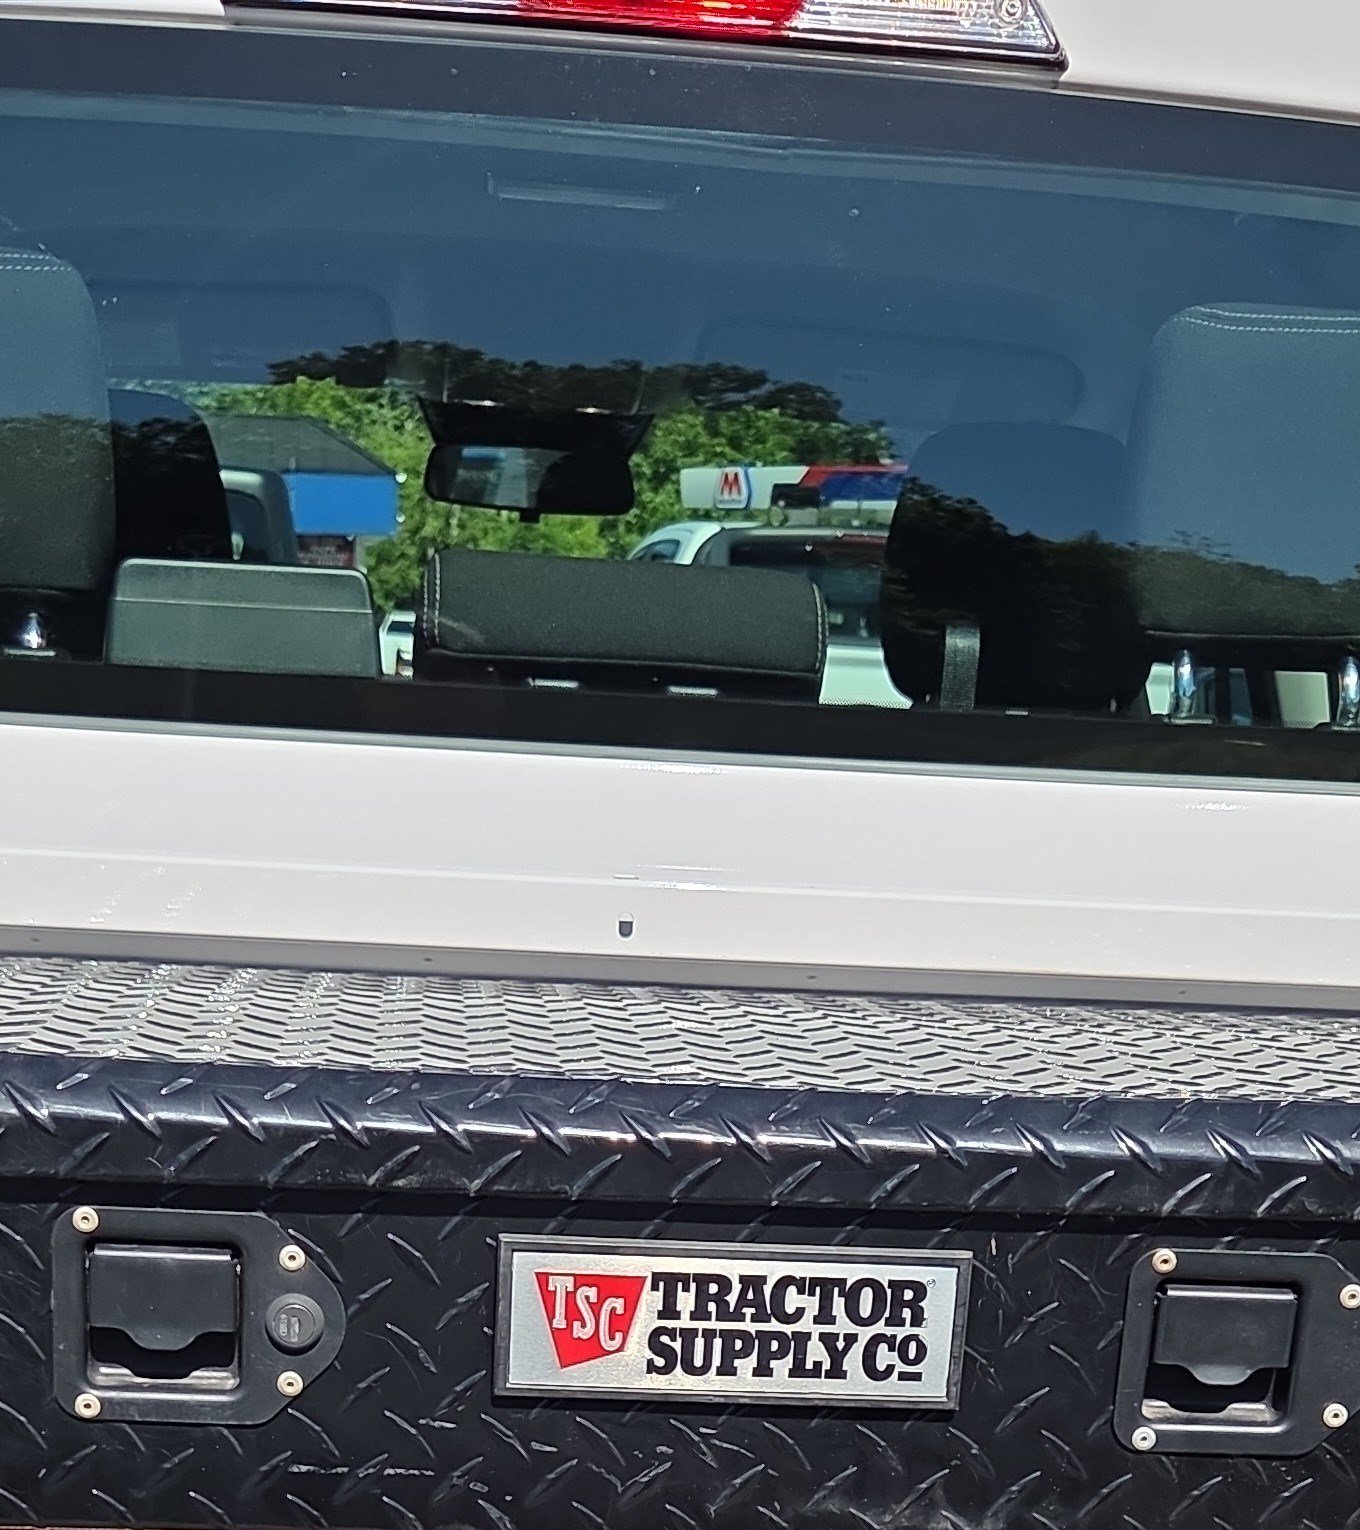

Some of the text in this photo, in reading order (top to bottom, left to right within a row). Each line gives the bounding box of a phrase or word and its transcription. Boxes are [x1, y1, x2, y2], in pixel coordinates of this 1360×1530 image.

[547, 1275, 625, 1352] TSC
[650, 1271, 928, 1328] TRACTOR
[646, 1326, 859, 1380] SUPPLY
